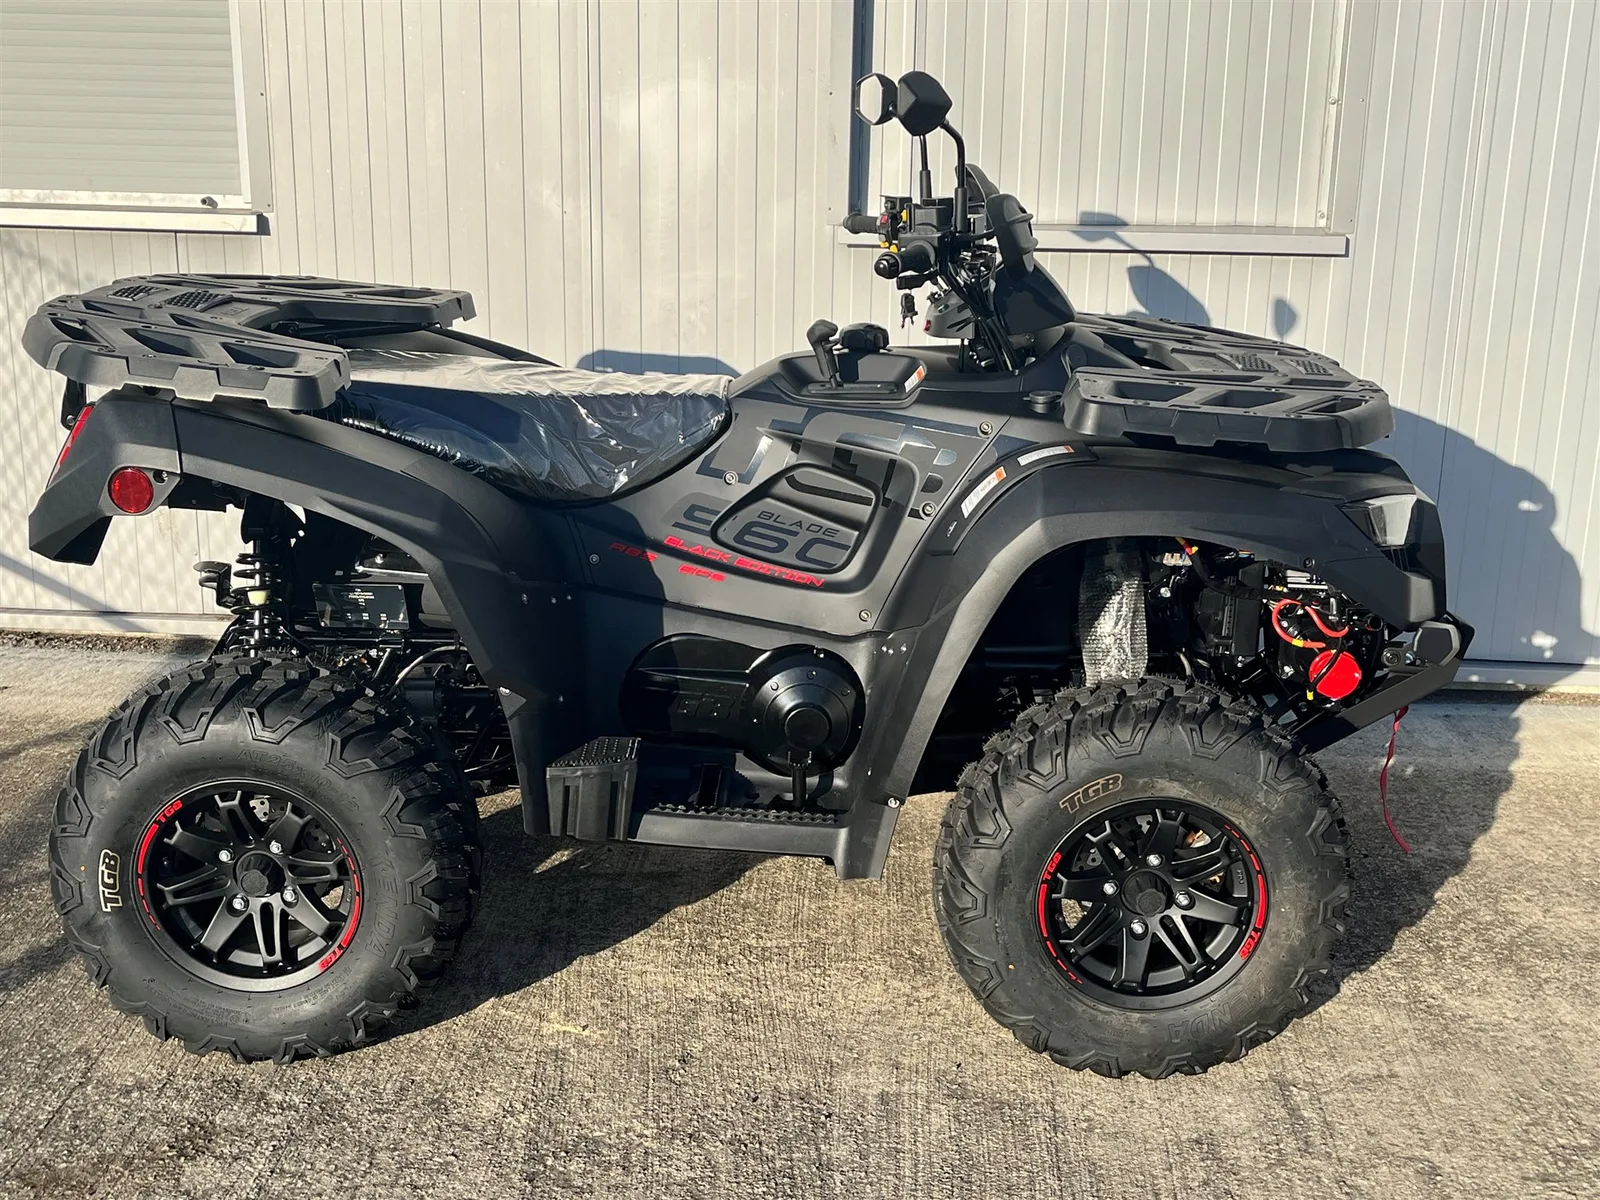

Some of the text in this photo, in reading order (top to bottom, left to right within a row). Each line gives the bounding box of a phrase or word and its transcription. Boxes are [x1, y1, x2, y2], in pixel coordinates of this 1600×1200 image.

[757, 510, 840, 538] BLADE
[609, 542, 658, 563] ABS
[664, 535, 825, 588] BLACK EDITION
[677, 563, 727, 583] EPS
[1059, 773, 1123, 814] TGB
[156, 799, 183, 823] TGB
[1042, 851, 1062, 880] TGB
[99, 848, 122, 913] TGB
[1167, 968, 1275, 1043] KENDA
